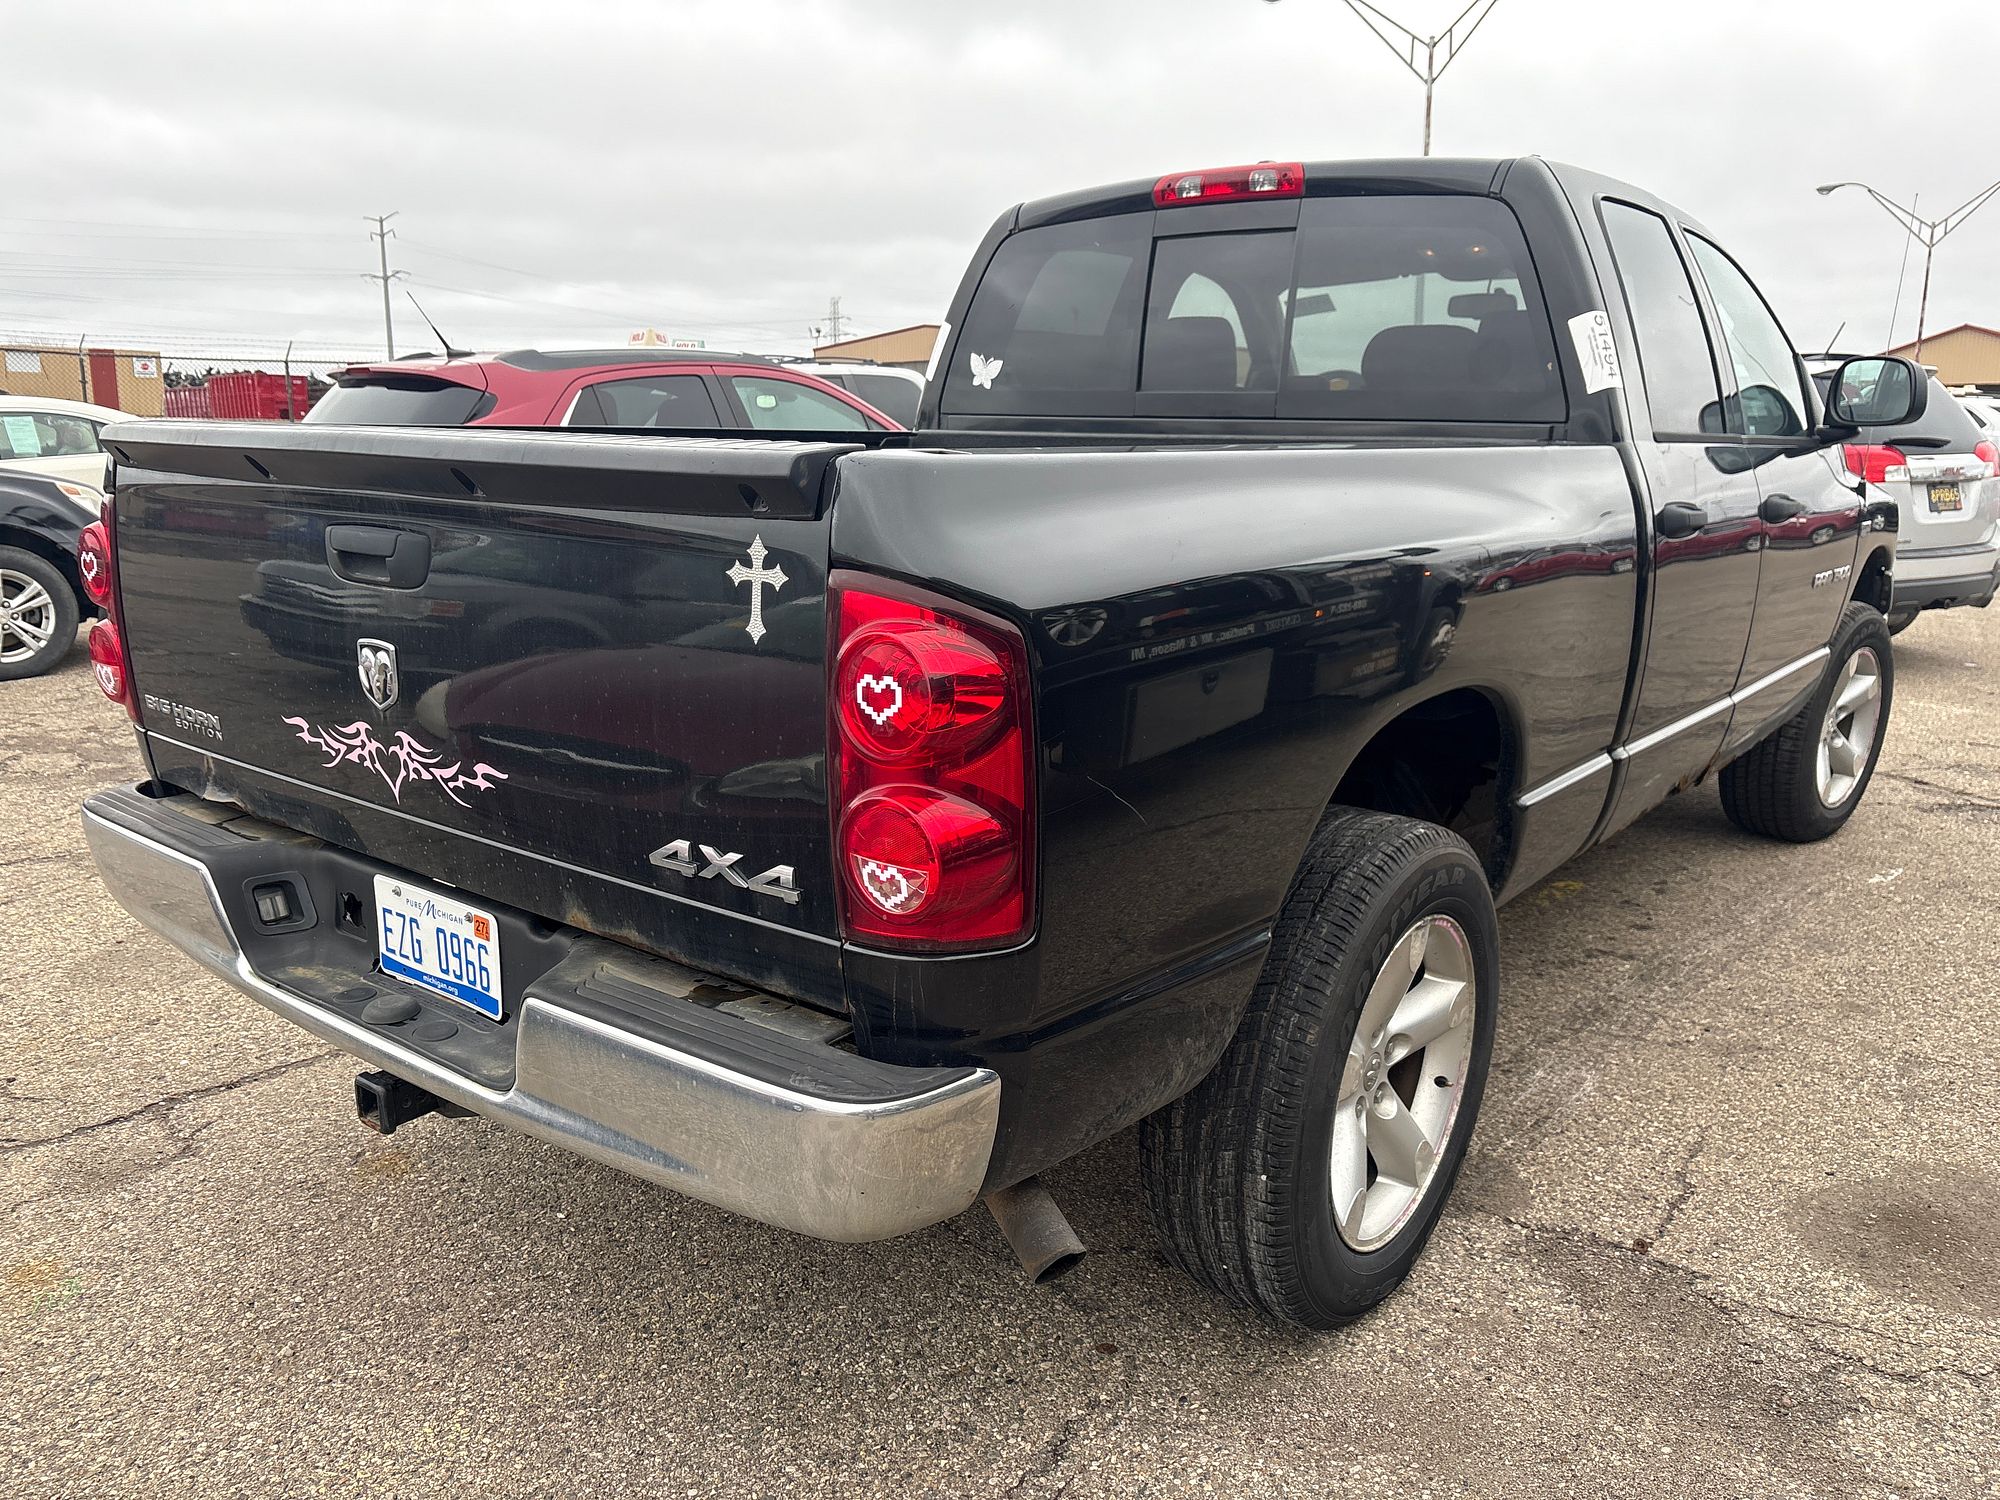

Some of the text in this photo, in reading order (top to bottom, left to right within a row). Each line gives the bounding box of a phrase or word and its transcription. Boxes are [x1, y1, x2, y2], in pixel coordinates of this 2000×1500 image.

[1594, 314, 1617, 379] 51494
[144, 693, 221, 731] BIG HORN
[175, 717, 224, 741] EDITION
[649, 839, 801, 905] 4X4
[406, 898, 422, 910] PURE
[475, 919, 486, 933] 27
[382, 907, 492, 993] EZG 0966
[423, 975, 459, 995] michigan.org
